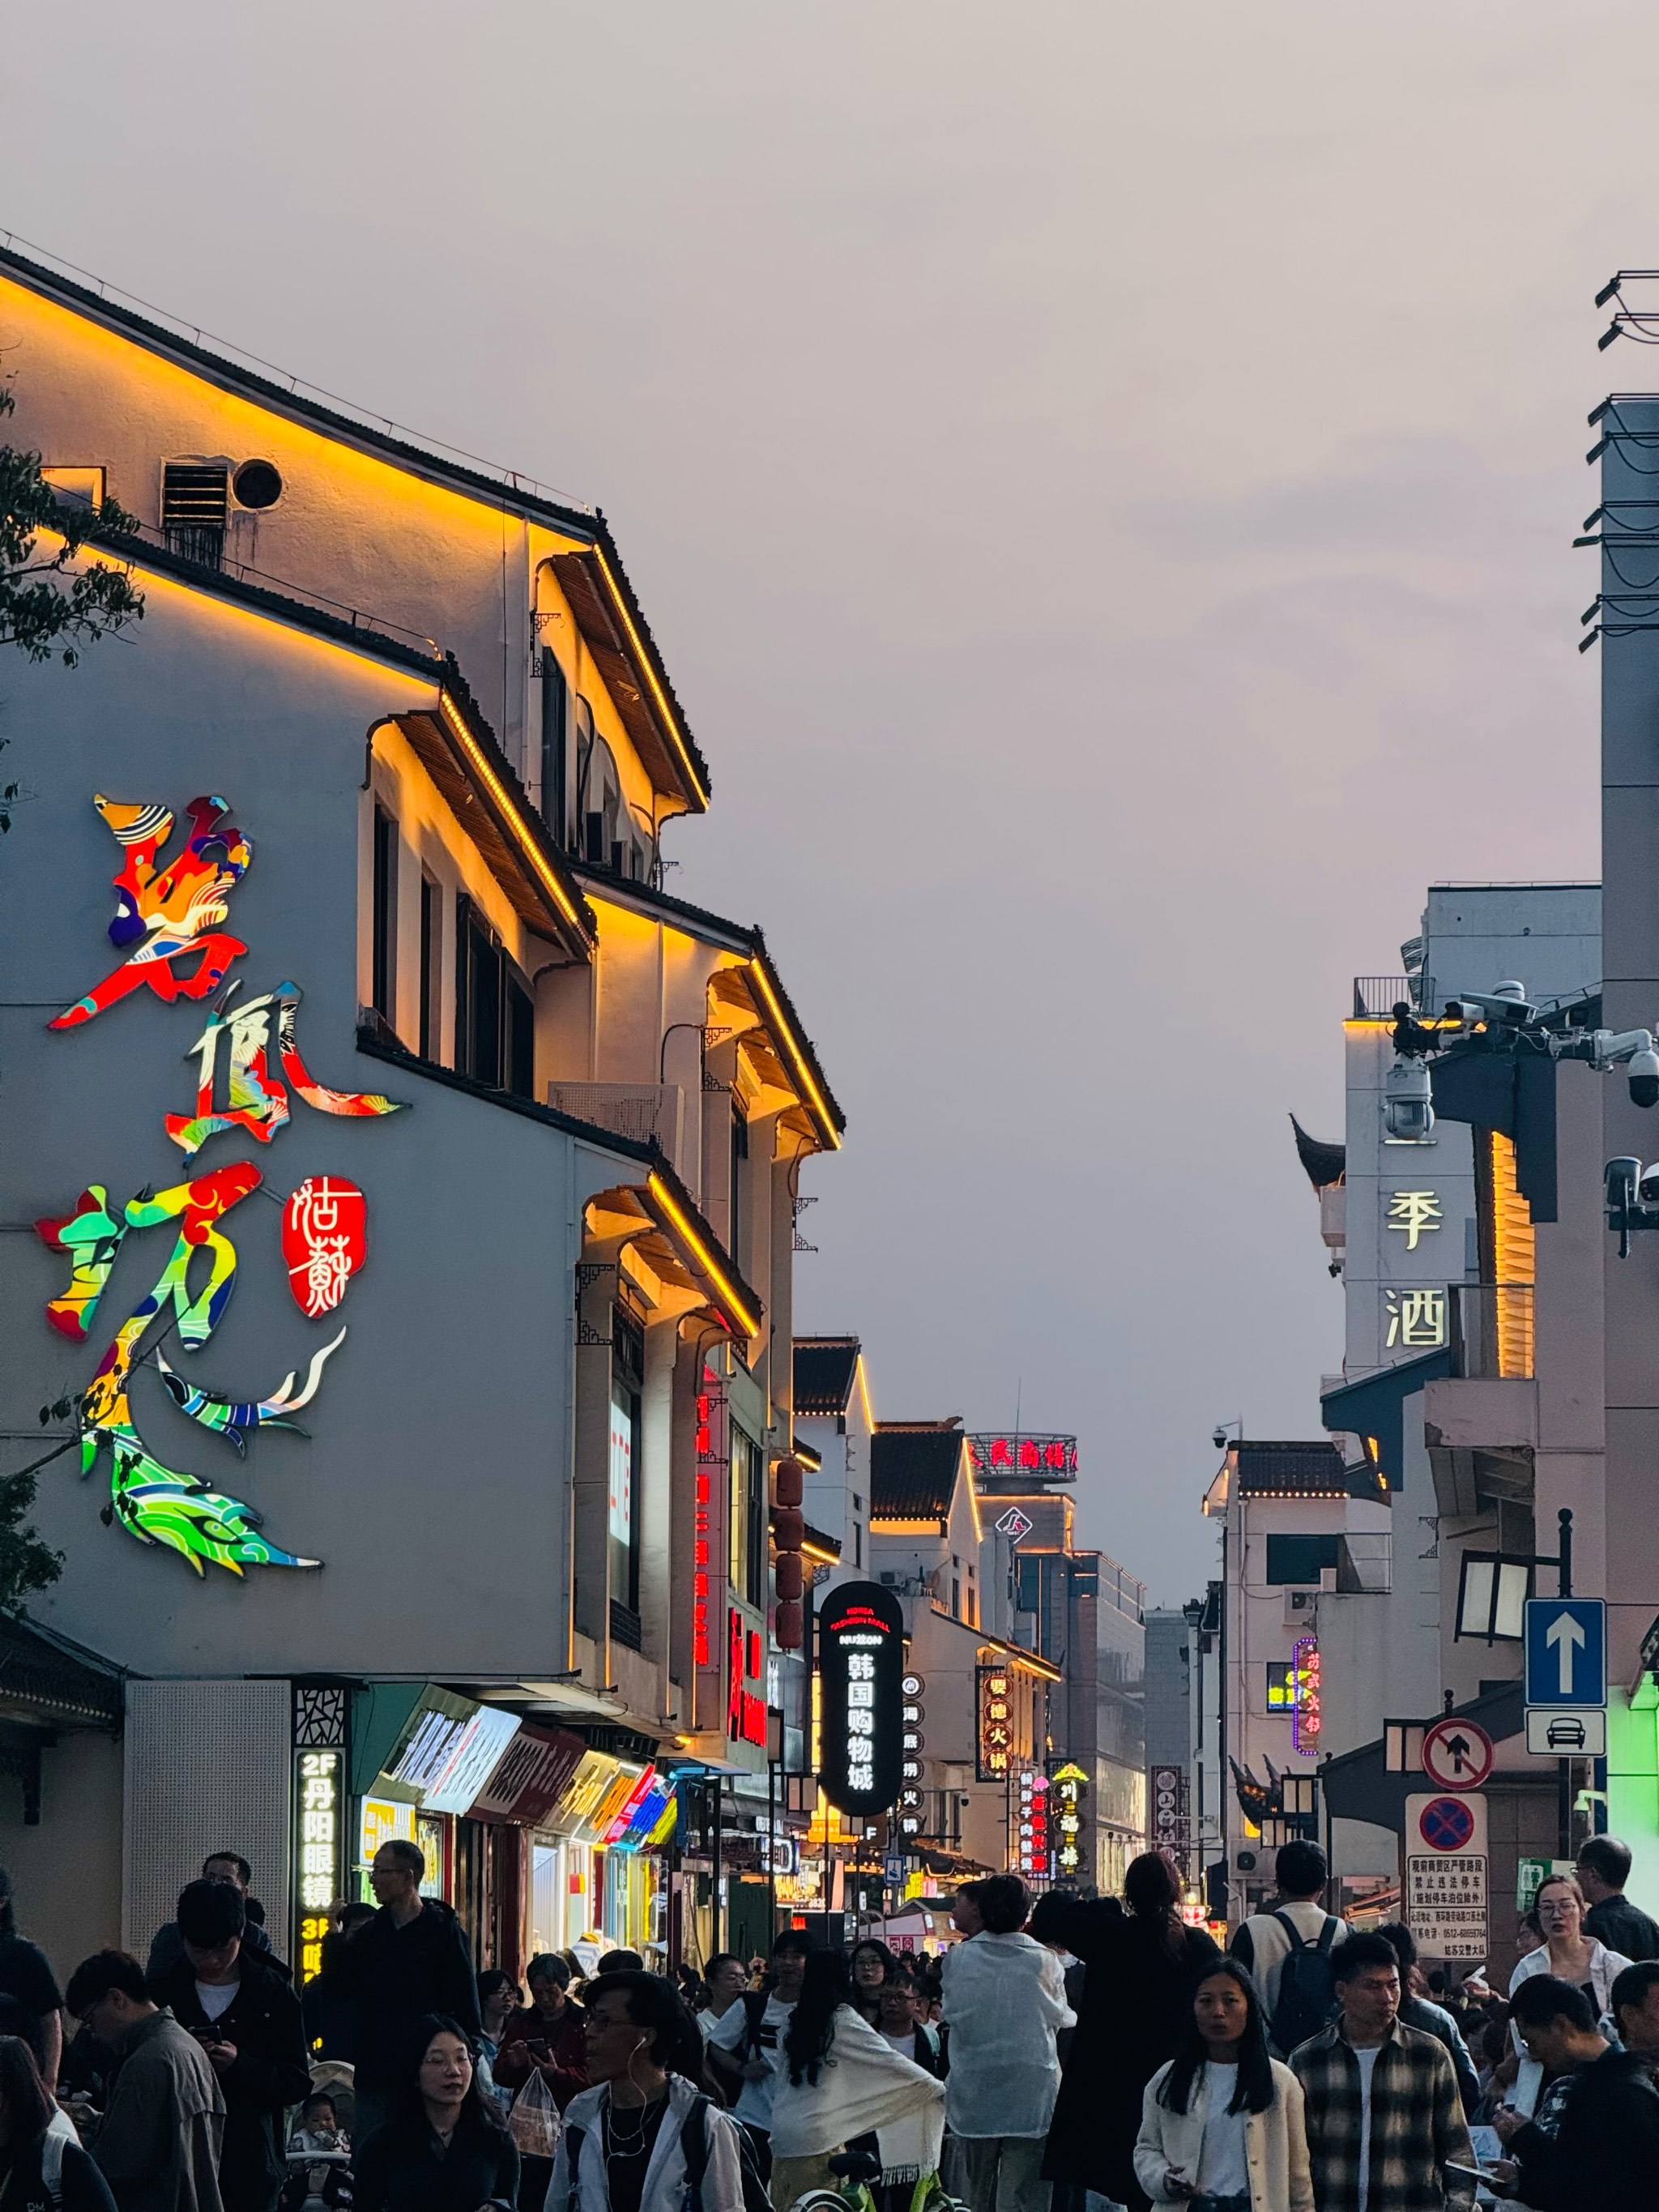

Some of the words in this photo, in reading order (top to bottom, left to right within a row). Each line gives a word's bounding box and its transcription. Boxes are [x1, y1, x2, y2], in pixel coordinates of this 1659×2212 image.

[1384, 1139, 1444, 1347] 季酒
[847, 1606, 874, 1616] KOREA
[868, 1617, 891, 1633] MALL
[847, 1653, 874, 1791] 韩国购物城
[989, 1679, 1008, 1770] 要德火锅
[302, 1753, 336, 1776] 2F
[902, 1706, 919, 1834] 海底捞火锅
[302, 1777, 335, 1908] 丹阳眼镜
[1412, 1859, 1483, 1873] 观前商贸区严管路段
[1414, 1876, 1481, 1890] 禁止违法停车
